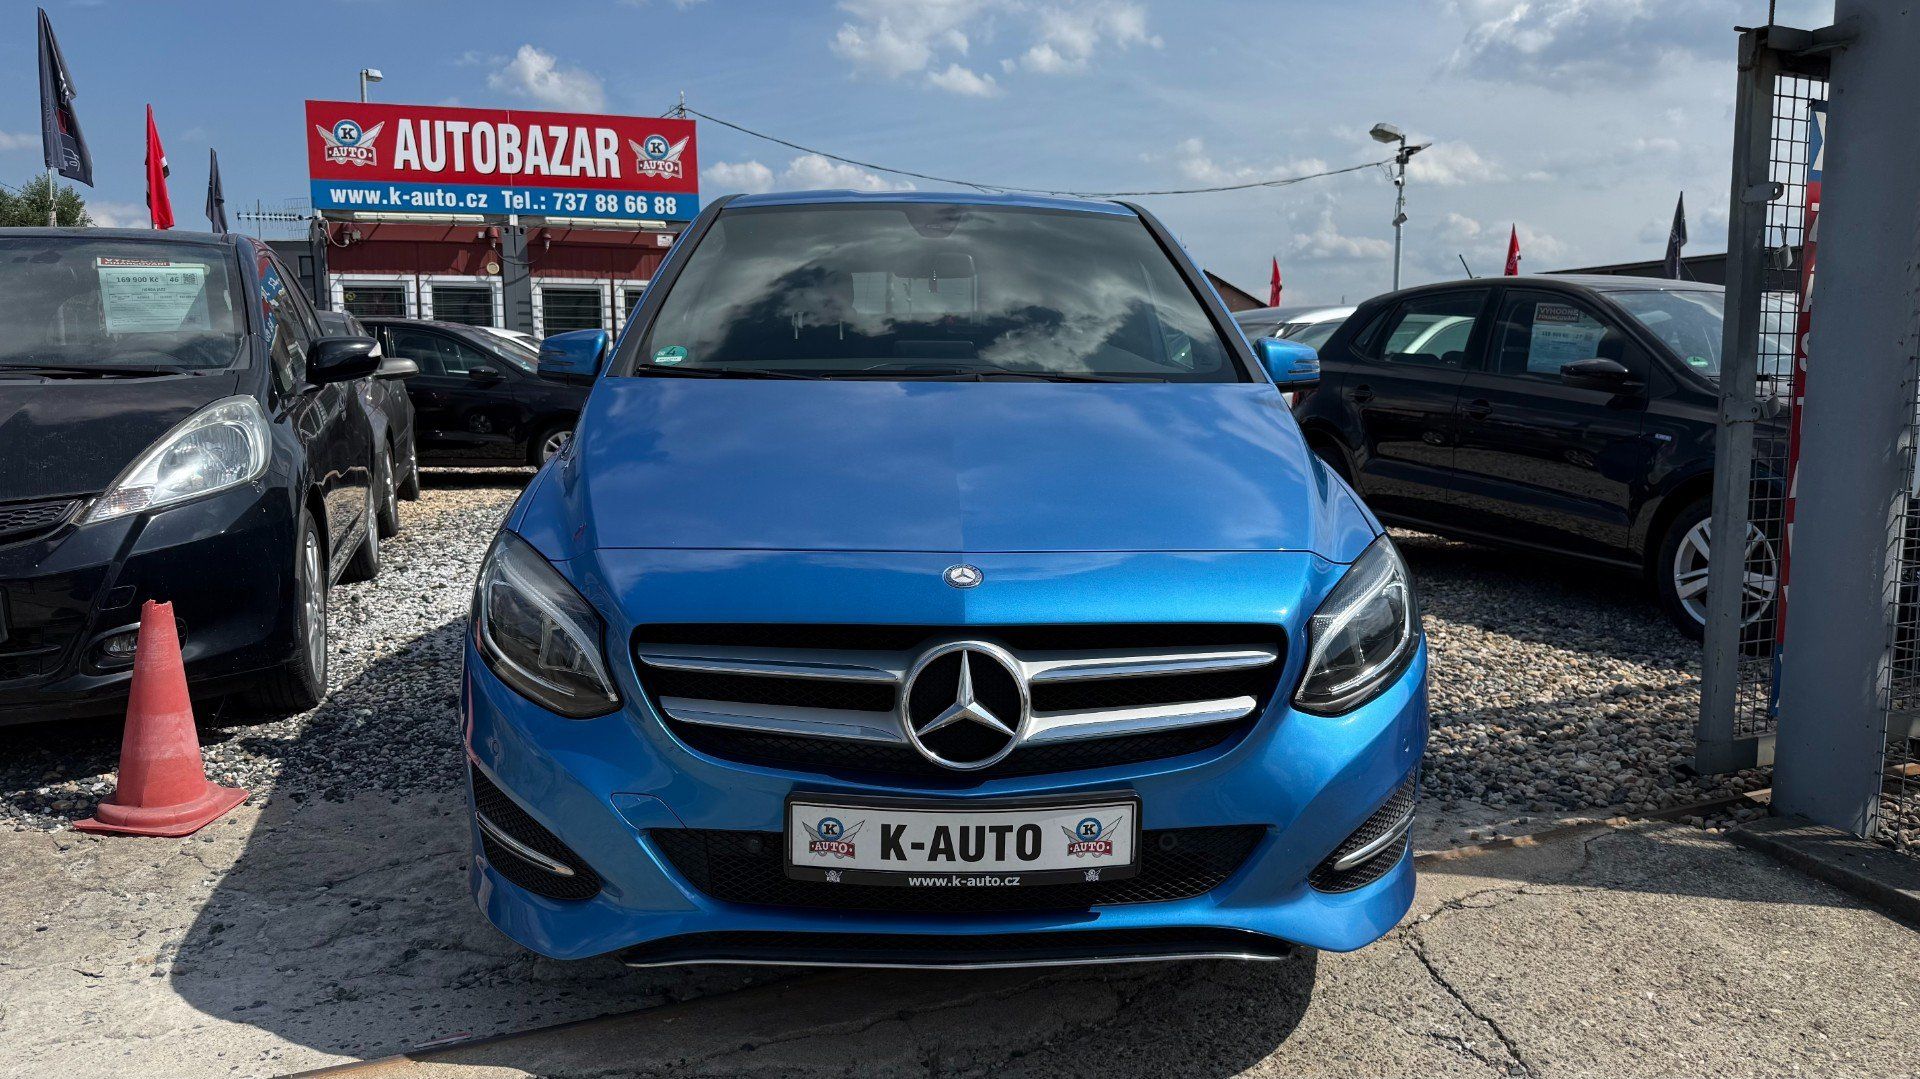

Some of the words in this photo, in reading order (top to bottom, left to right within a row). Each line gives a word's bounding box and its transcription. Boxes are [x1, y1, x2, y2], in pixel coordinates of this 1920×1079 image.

[340, 127, 356, 140] K
[331, 147, 368, 159] AUTO
[393, 118, 622, 179] AUTOBAZAR
[650, 142, 663, 154] K
[642, 160, 673, 172] AUTO
[330, 187, 488, 208] www.k-auto.cz
[501, 190, 546, 210] Tel.:
[552, 193, 588, 211] 737
[595, 195, 619, 213] 88
[624, 196, 648, 214] 66
[653, 197, 677, 215] 88
[823, 823, 838, 835] K
[1082, 823, 1096, 836] K
[814, 841, 849, 853] AUTO
[880, 823, 1042, 863] K-AUTO
[1072, 841, 1106, 853] AUTO
[908, 875, 1021, 887] www.k-auto.cz
